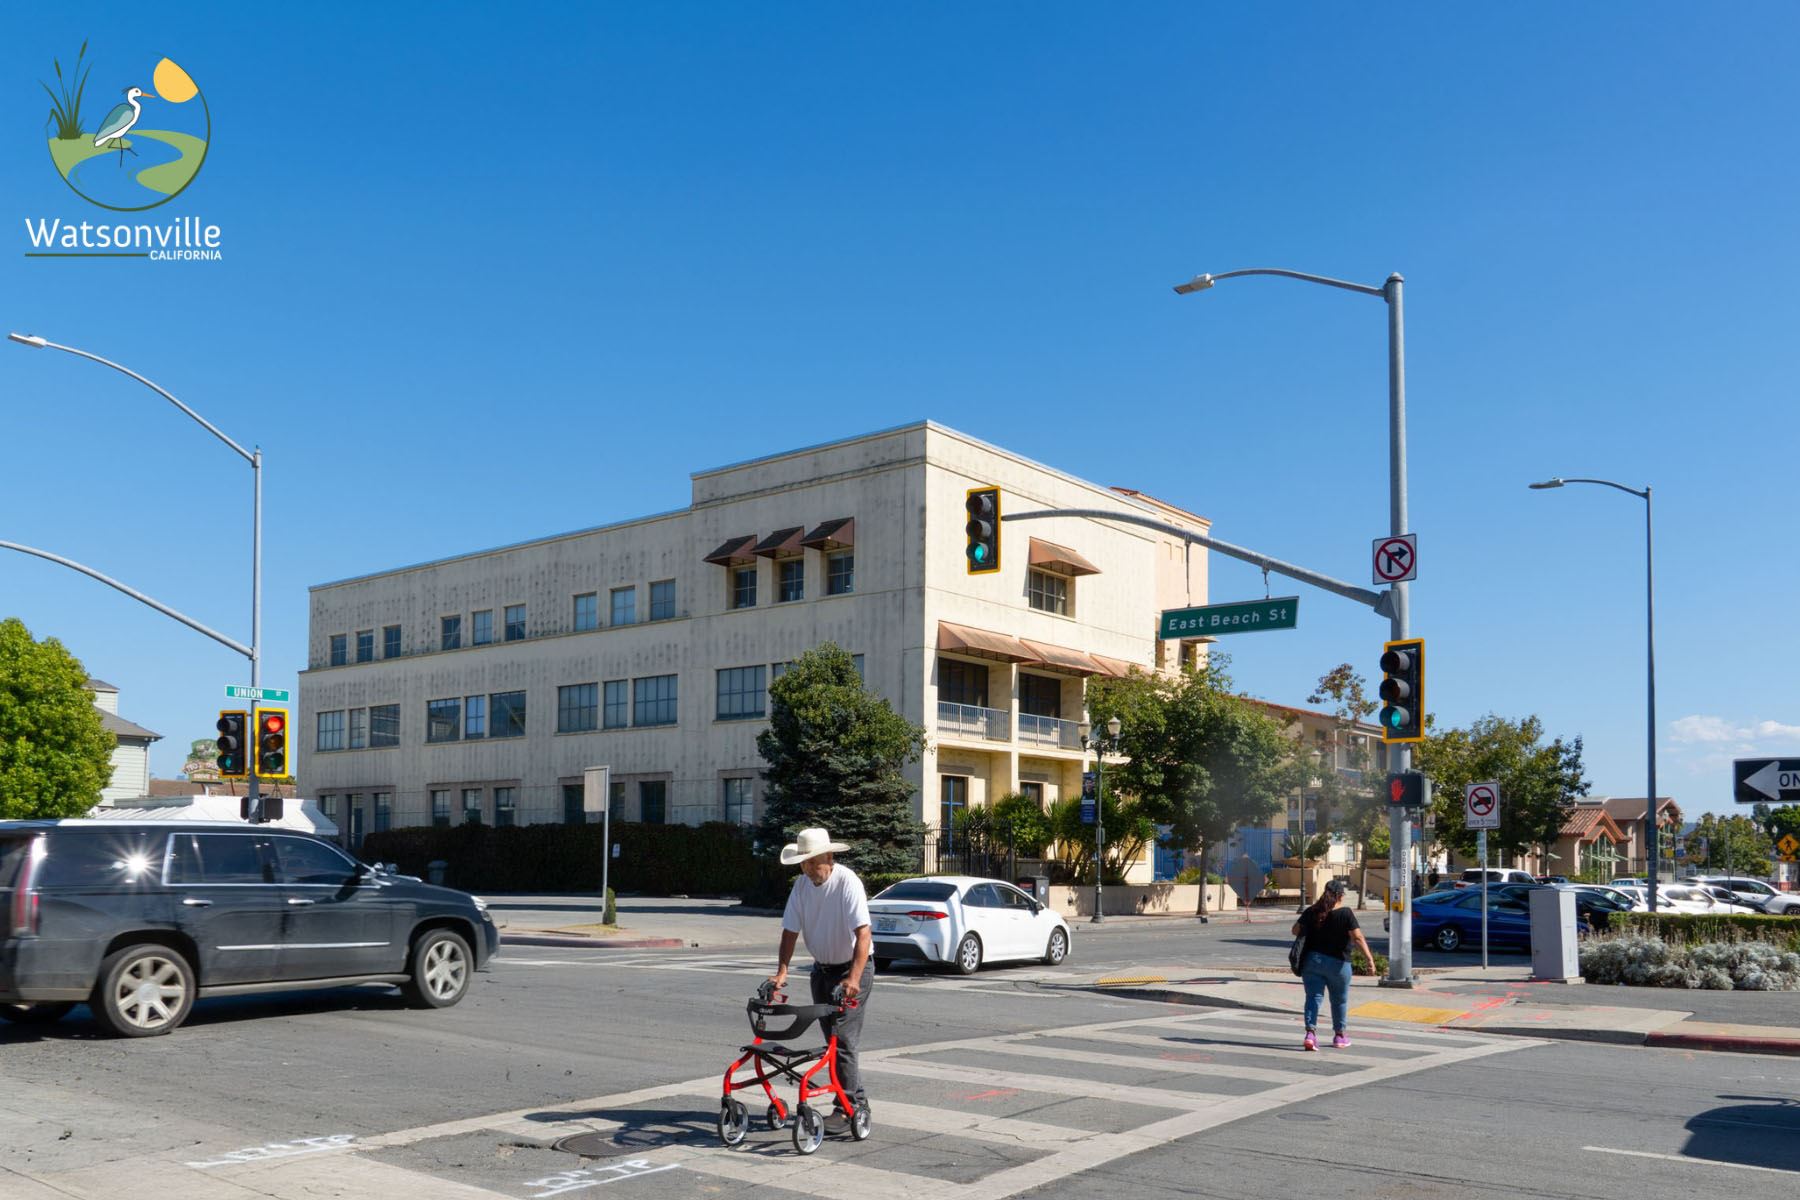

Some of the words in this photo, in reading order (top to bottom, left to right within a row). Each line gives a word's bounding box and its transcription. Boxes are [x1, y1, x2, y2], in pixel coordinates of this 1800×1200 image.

[1168, 616, 1204, 631] East
[1210, 611, 1260, 627] Beach
[1269, 608, 1287, 621] St
[234, 687, 263, 699] UNION
